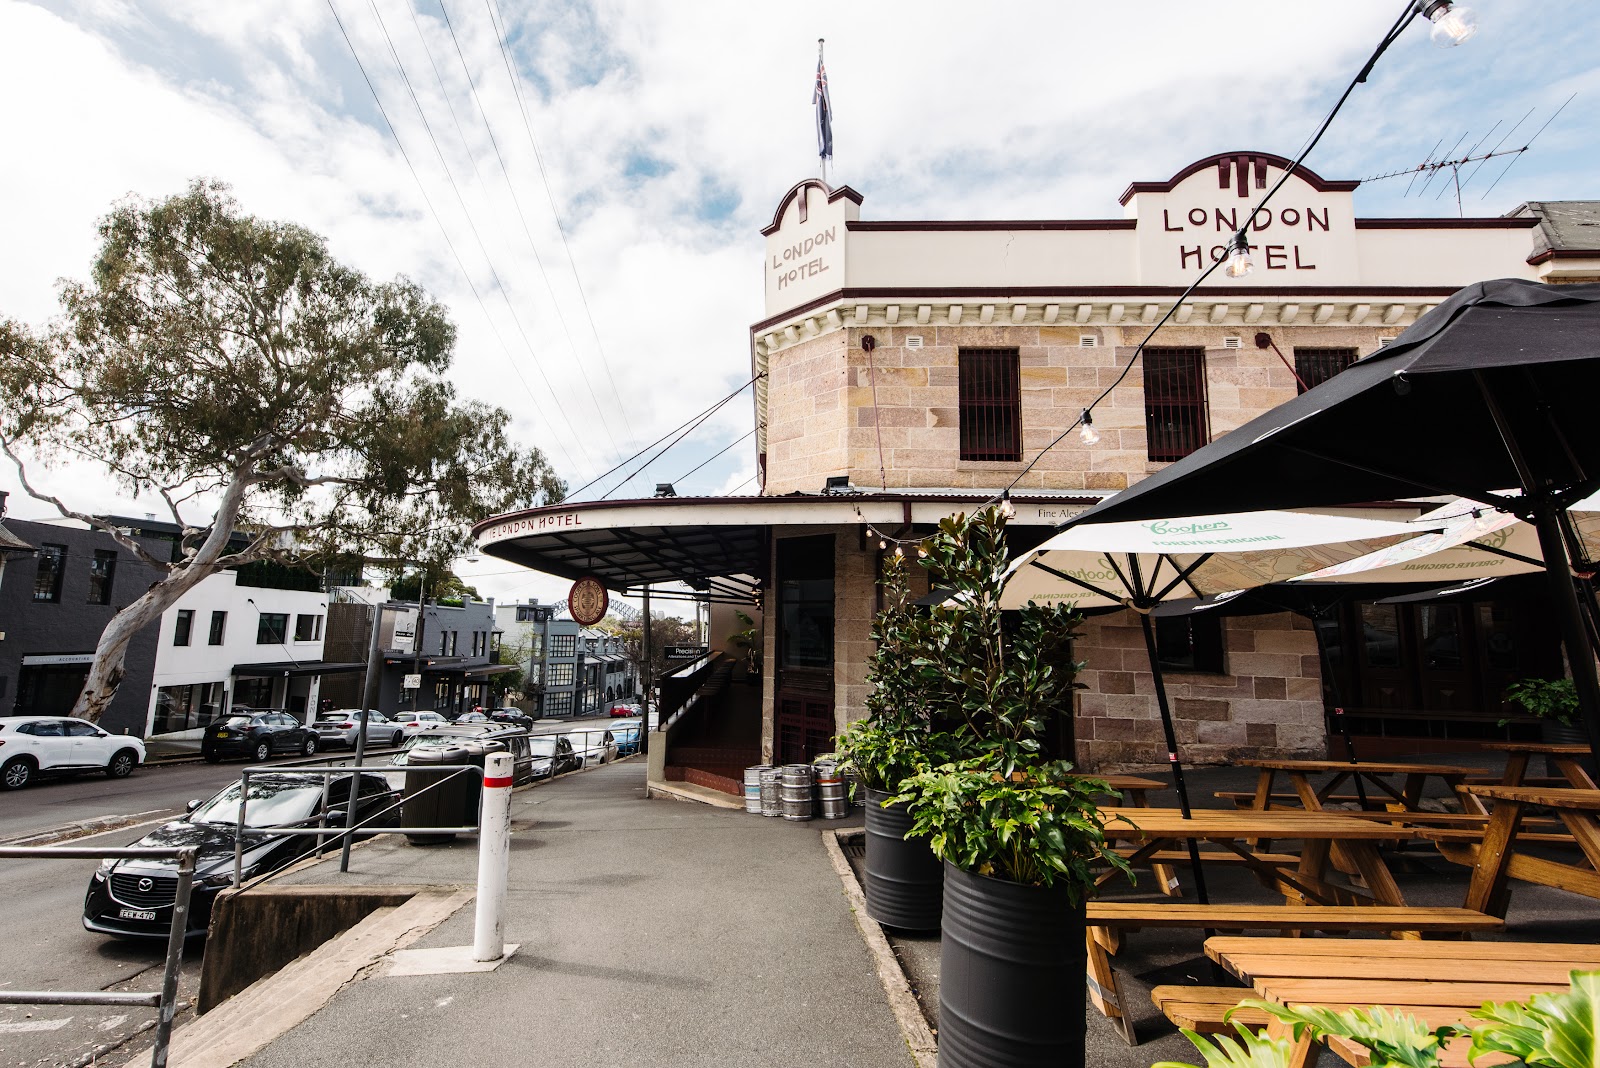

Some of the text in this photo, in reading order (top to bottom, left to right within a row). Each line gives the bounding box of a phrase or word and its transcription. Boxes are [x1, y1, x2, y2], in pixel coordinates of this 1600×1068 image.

[1163, 207, 1330, 232] LONDON
[773, 225, 836, 270] LONDON
[1180, 245, 1316, 270] HOEL
[778, 256, 830, 291] HOTEL
[498, 519, 535, 537] LONDON
[539, 514, 582, 529] HOTEL
[1038, 509, 1057, 518] Fine
[1059, 509, 1079, 518] Ales
[1141, 520, 1233, 537] Coopers
[1216, 535, 1286, 545] ORIGINAL
